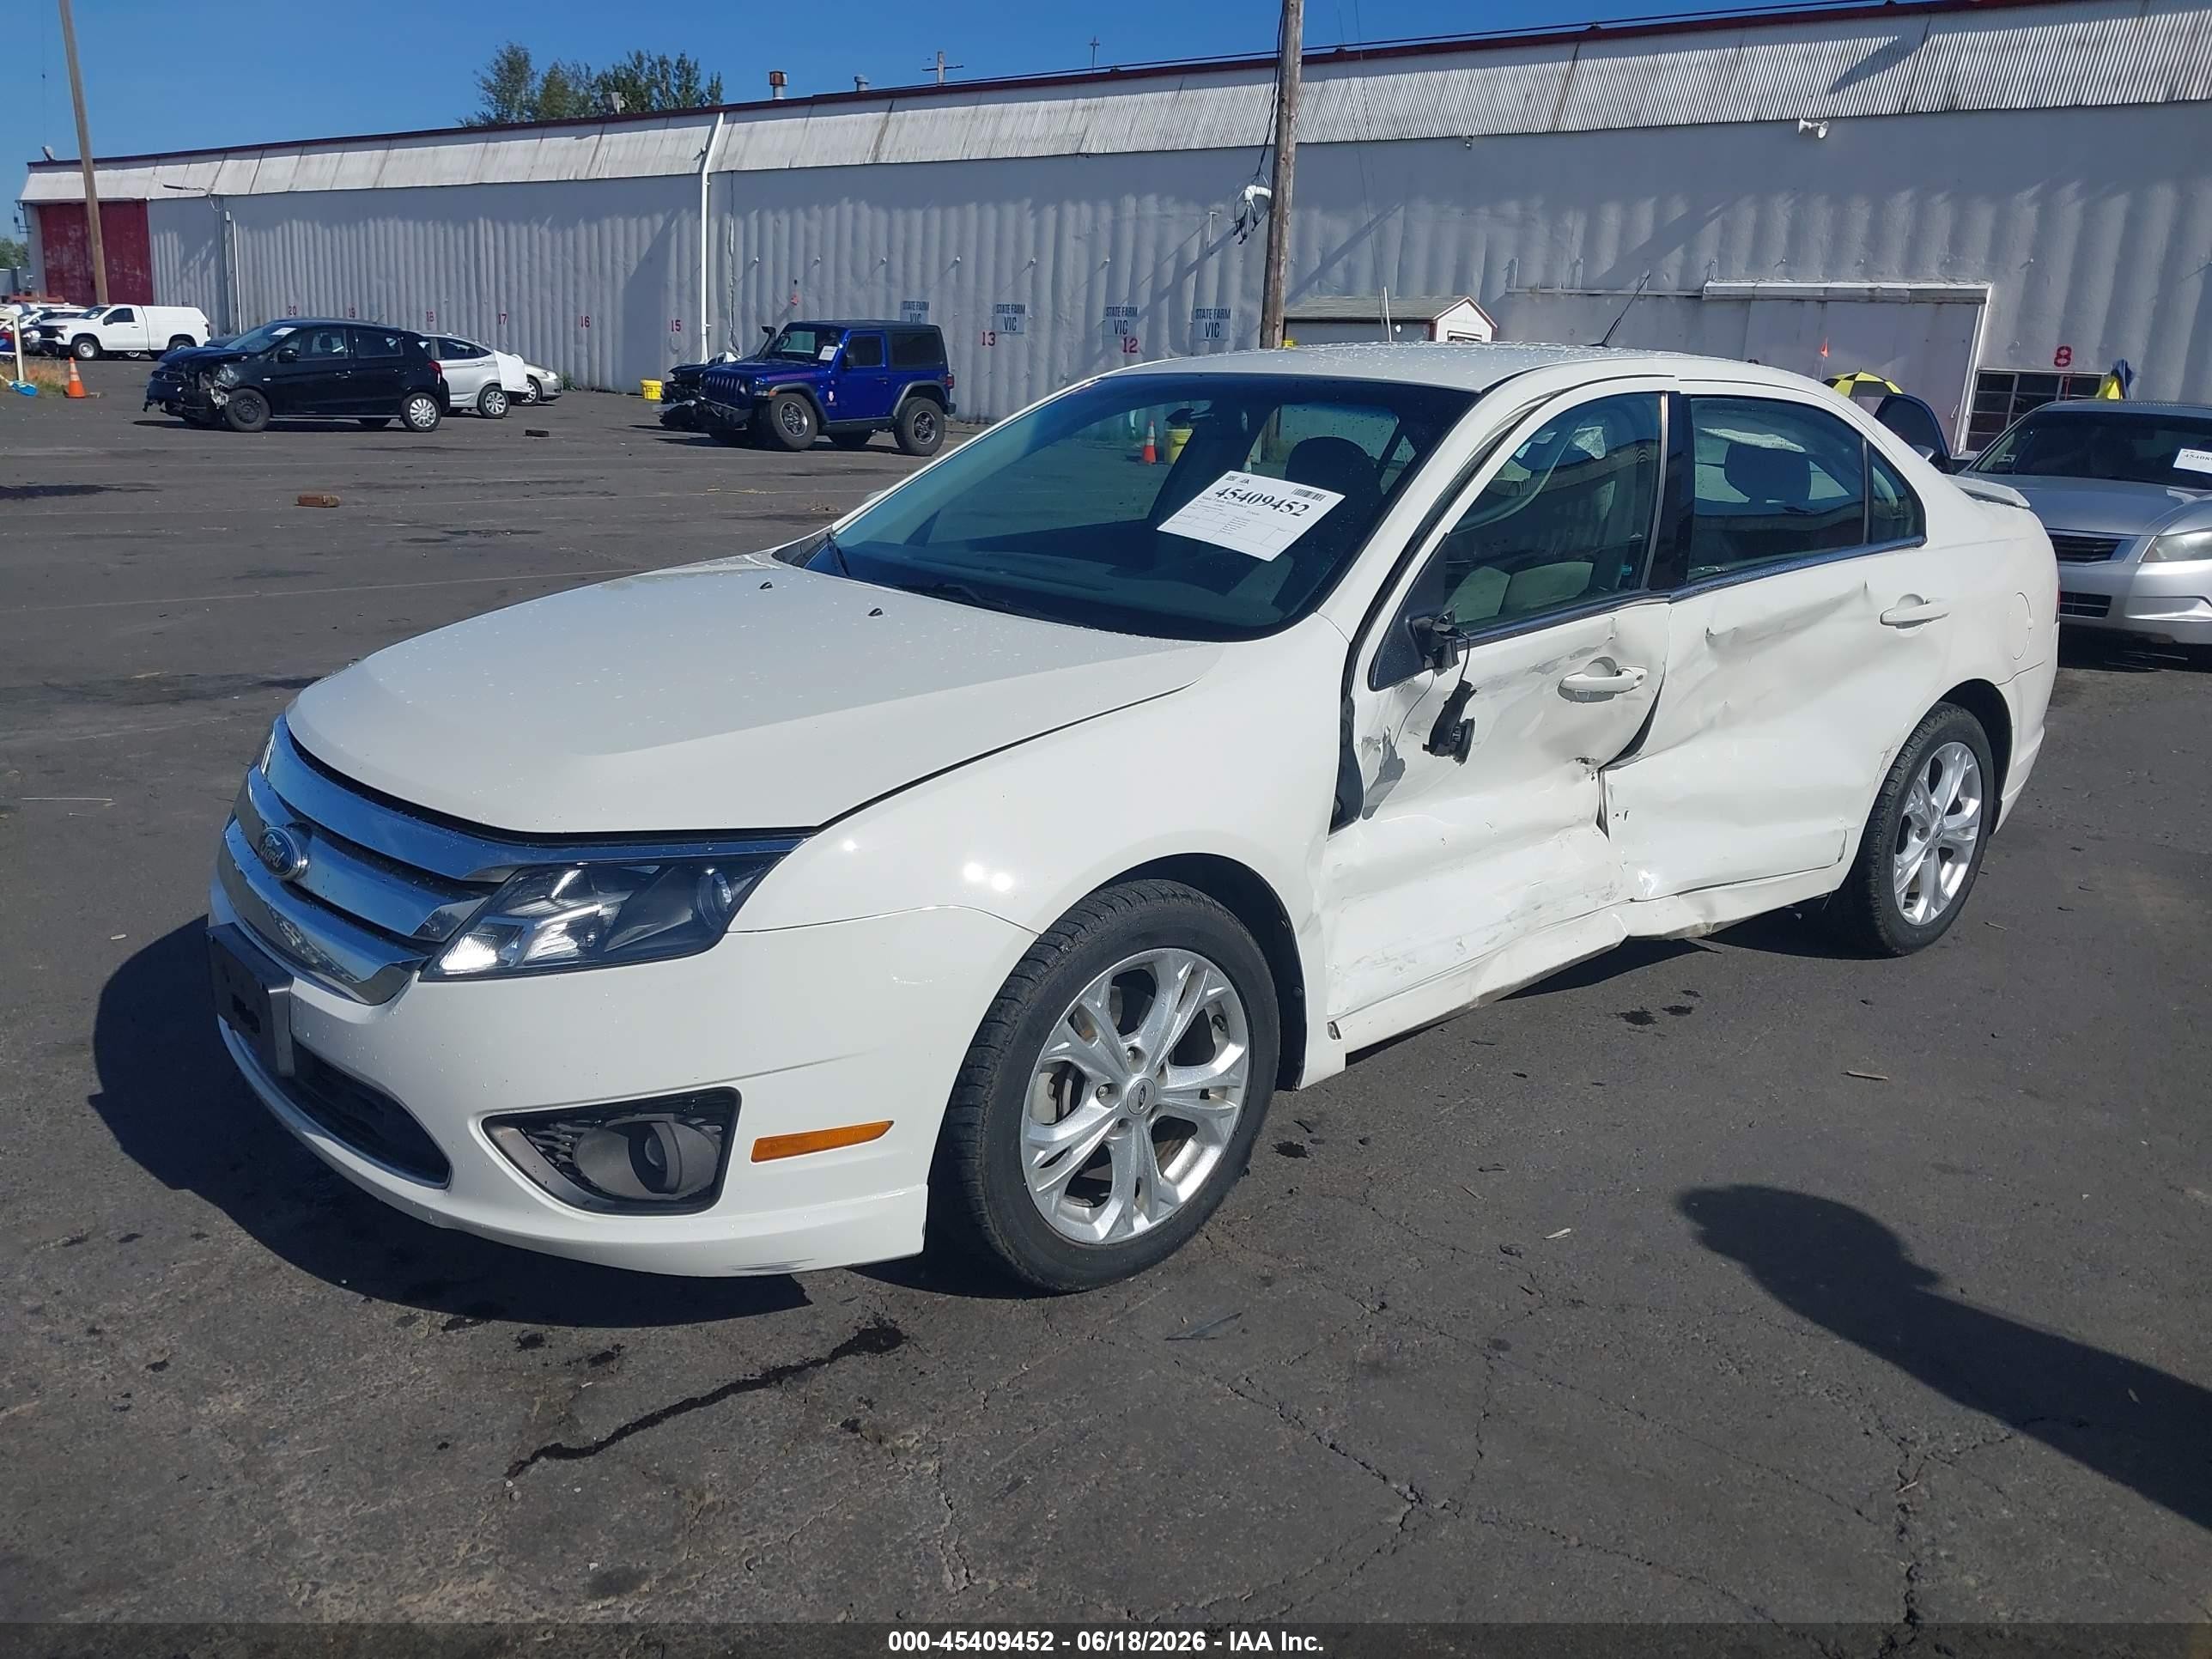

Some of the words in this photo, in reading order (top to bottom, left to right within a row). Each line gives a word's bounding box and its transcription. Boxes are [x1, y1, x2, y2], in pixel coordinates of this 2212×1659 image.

[288, 306, 297, 315] 20
[1106, 307, 1121, 317] STATE
[1121, 307, 1138, 317] FARM
[1195, 308, 1212, 319] STATE
[1213, 308, 1231, 319] FARM
[498, 313, 507, 325] 17
[580, 316, 591, 328] 16
[671, 319, 681, 331] 15
[1004, 317, 1017, 331] VIC
[1114, 319, 1127, 335] VIC
[1205, 322, 1220, 338] VIC
[981, 331, 996, 346] 13
[1122, 337, 1138, 353] 12
[2054, 346, 2073, 368] 8
[1215, 487, 1310, 517] 45409452
[259, 834, 285, 869] Ford
